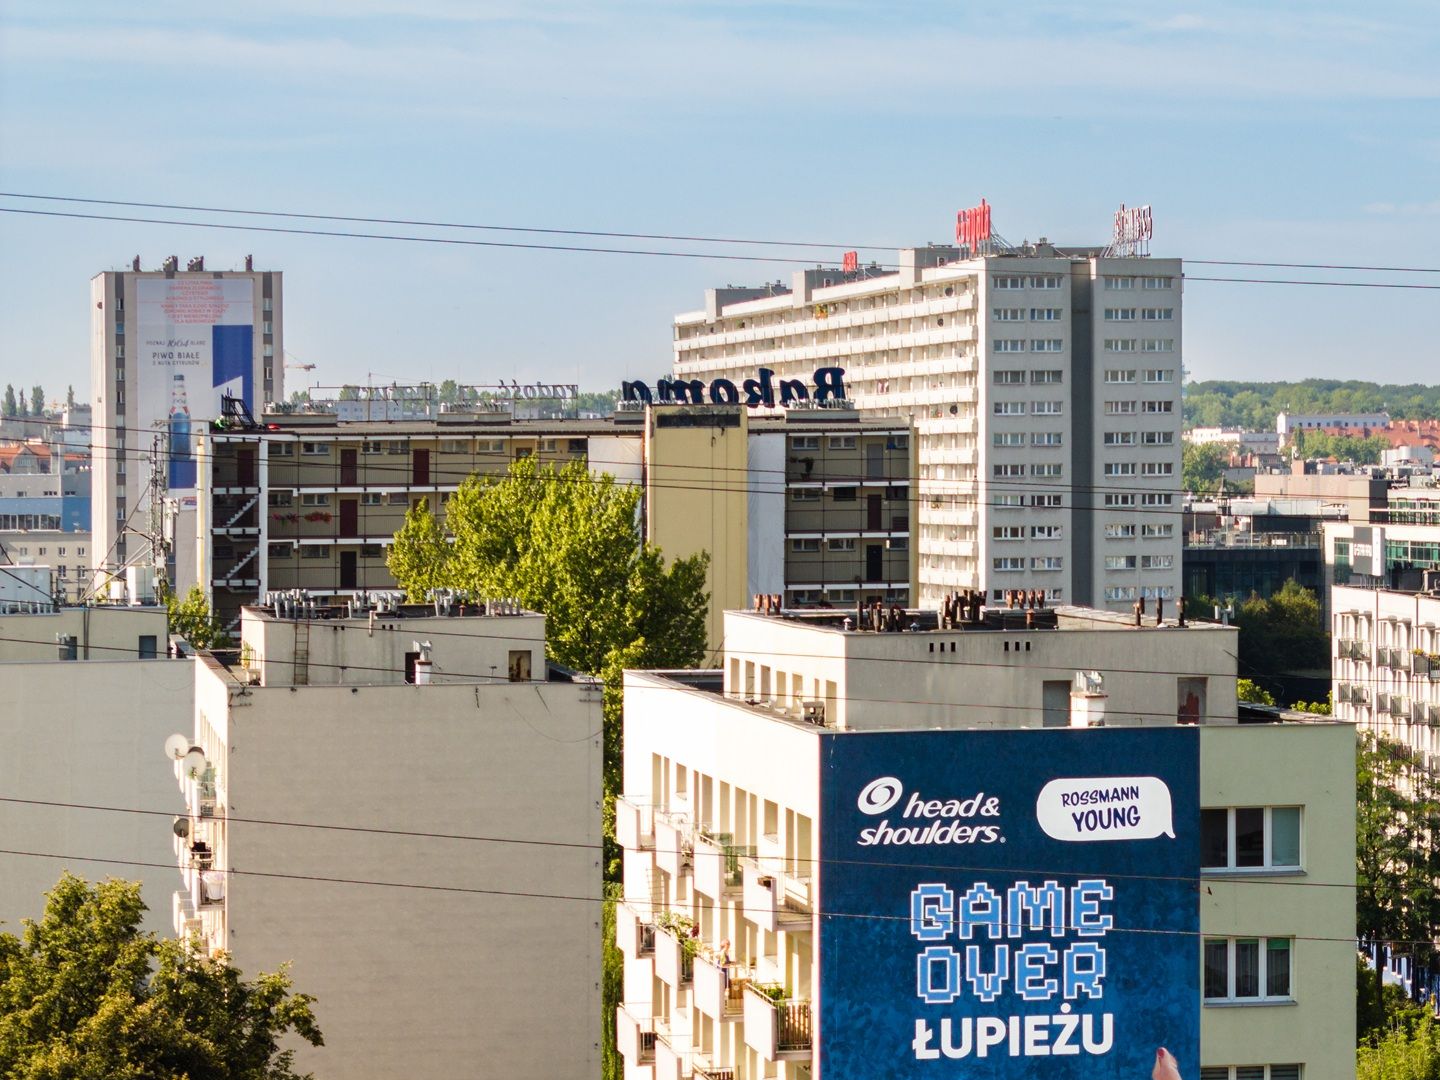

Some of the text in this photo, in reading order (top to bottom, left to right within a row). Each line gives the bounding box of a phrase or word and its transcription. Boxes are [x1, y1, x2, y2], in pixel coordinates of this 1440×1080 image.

[1061, 785, 1140, 808] ROSSMANN
[1071, 805, 1141, 833] YOUNG
[910, 879, 1114, 940] GAME
[917, 942, 1106, 1004] OVER
[912, 1003, 1114, 1060] ŁUPIEŻU
